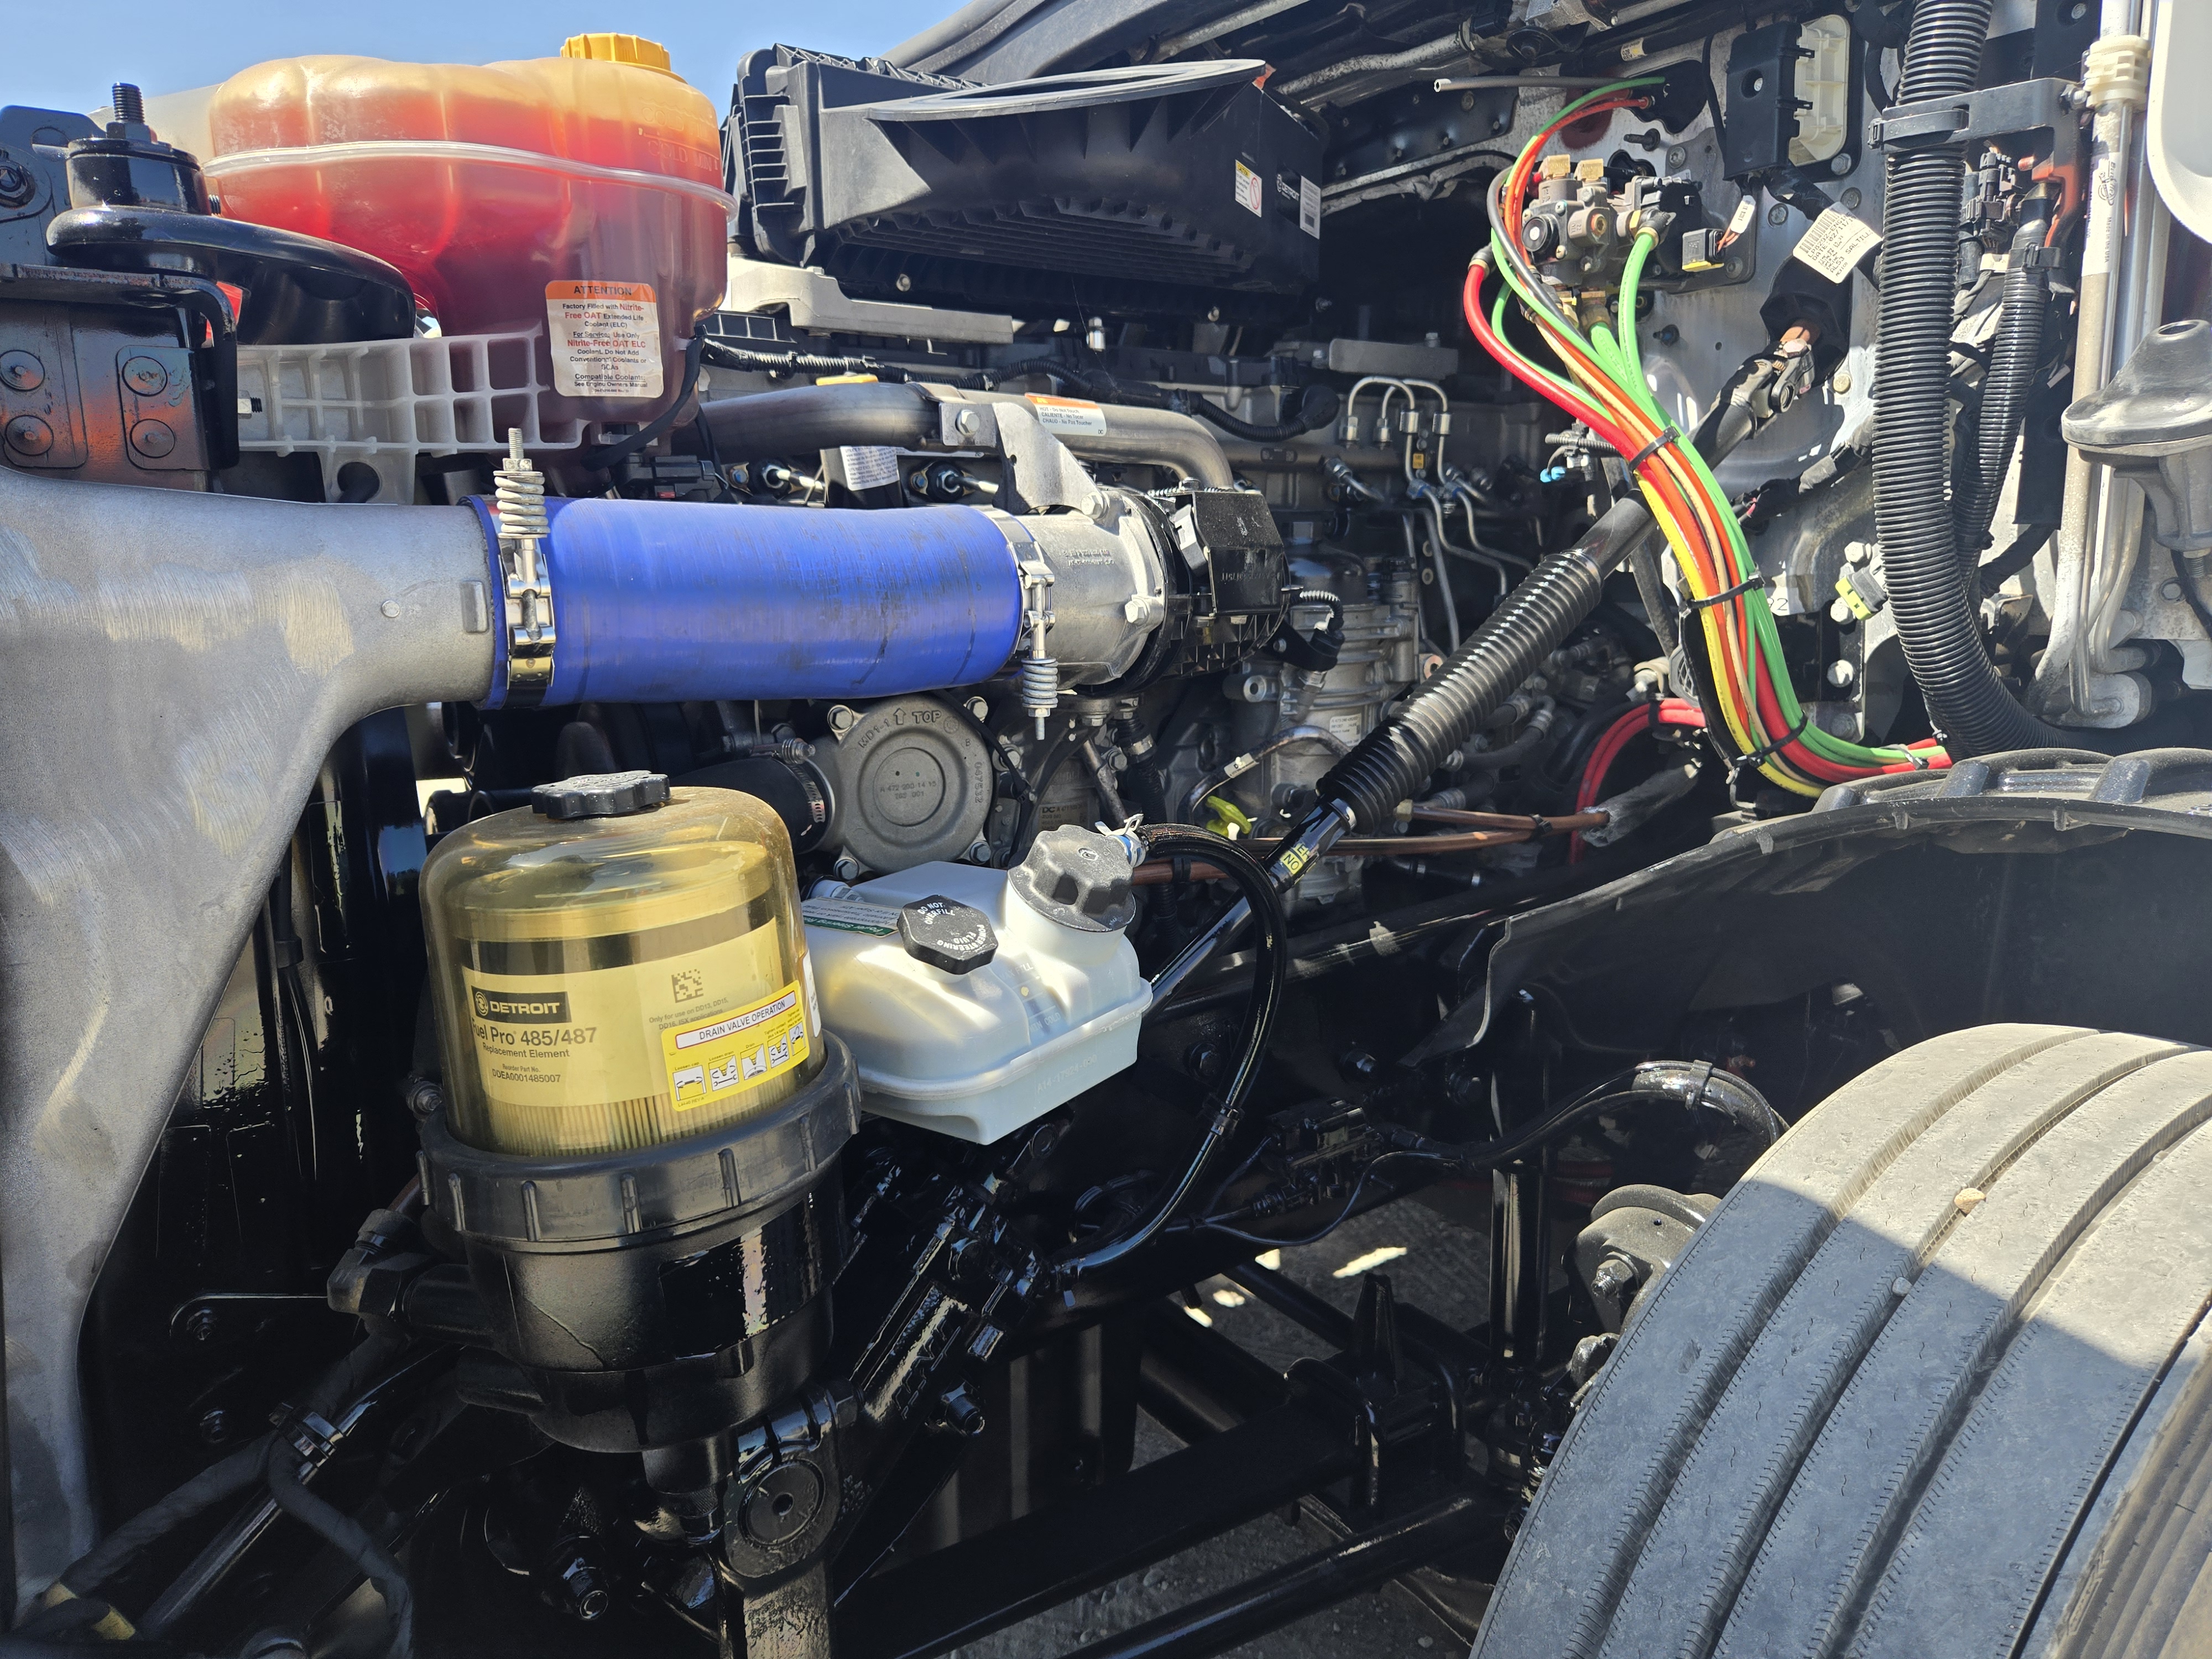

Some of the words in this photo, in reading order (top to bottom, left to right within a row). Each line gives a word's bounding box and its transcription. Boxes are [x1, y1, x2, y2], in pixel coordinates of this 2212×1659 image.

[1282, 182, 1300, 201] DETROIT
[1829, 255, 1845, 273] AL53
[573, 286, 632, 295] ATTENTION
[912, 710, 941, 724] TOP
[858, 719, 890, 748] MD1-1
[974, 761, 984, 804] 047532
[1283, 854, 1300, 870] NO
[917, 906, 928, 915] DO
[924, 909, 956, 925] OVERFILL
[817, 919, 853, 928] Steering
[953, 931, 977, 944] FLUID
[977, 924, 987, 946] POWER
[937, 940, 979, 951] STEERING
[1015, 963, 1034, 975] FILL
[489, 1001, 560, 1014] DETROIT
[649, 1015, 663, 1024] Only
[695, 1003, 712, 1013] DD13,
[713, 997, 729, 1006] DD15,
[691, 1008, 723, 1022] applications
[700, 1026, 726, 1040] DRAIN
[727, 1016, 750, 1031] VALVE
[752, 1000, 786, 1021] OPERATION
[1045, 1012, 1061, 1026] COLD
[490, 1026, 515, 1045] Pro
[520, 1026, 597, 1046] 485/487
[483, 1042, 527, 1057] Replacement
[529, 1049, 570, 1058] Element
[502, 1063, 519, 1072] Reorder
[492, 1068, 561, 1083] DDEA0001485007
